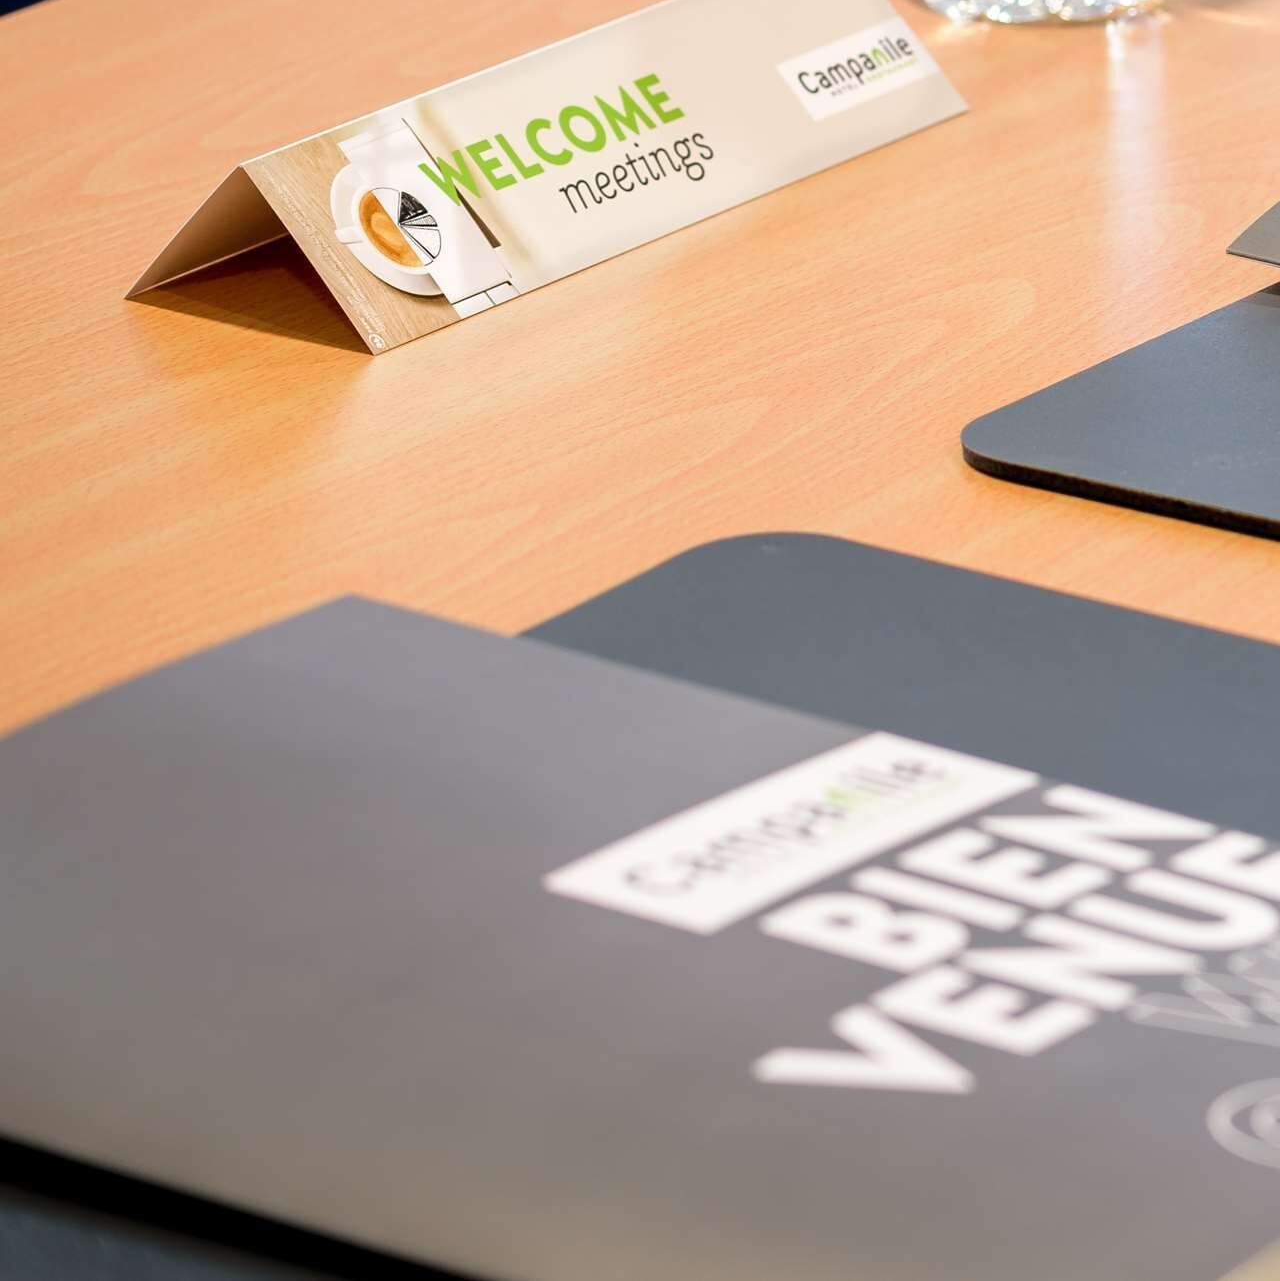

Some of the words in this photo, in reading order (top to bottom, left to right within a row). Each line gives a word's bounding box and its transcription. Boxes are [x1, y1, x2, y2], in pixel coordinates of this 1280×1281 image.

[798, 37, 913, 94] Campanile
[417, 73, 685, 207] WELCOME
[558, 132, 715, 214] meetings
[758, 784, 1218, 973] BIEN
